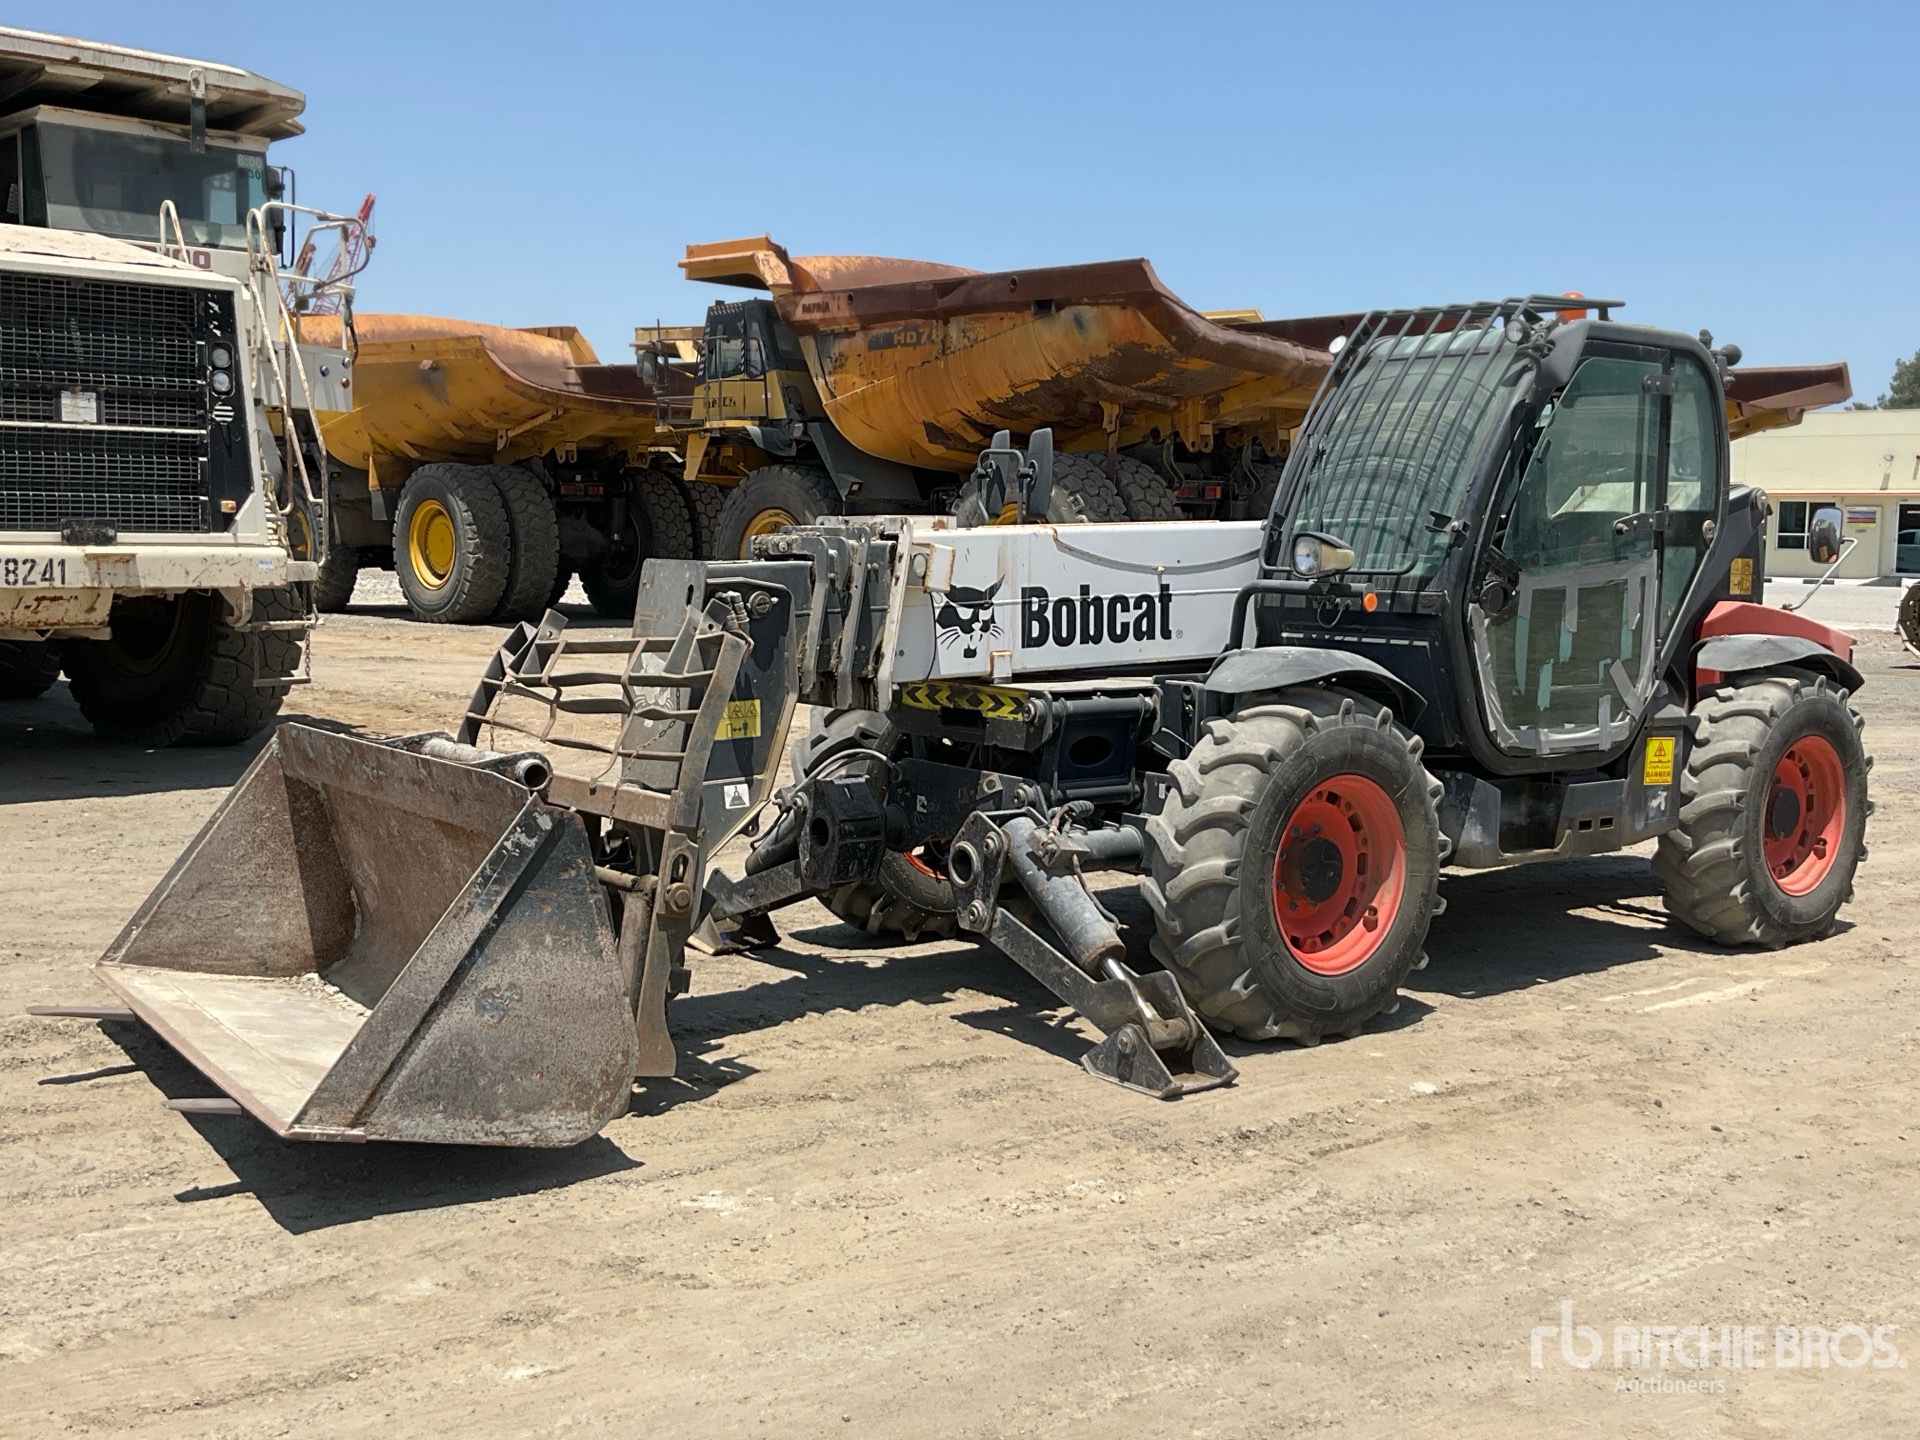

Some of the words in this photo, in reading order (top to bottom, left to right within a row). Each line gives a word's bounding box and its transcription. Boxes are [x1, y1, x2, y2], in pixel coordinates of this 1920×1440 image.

[237, 154, 262, 168] 8:00
[0, 558, 66, 586] 8241
[1021, 584, 1172, 648] Bobcat
